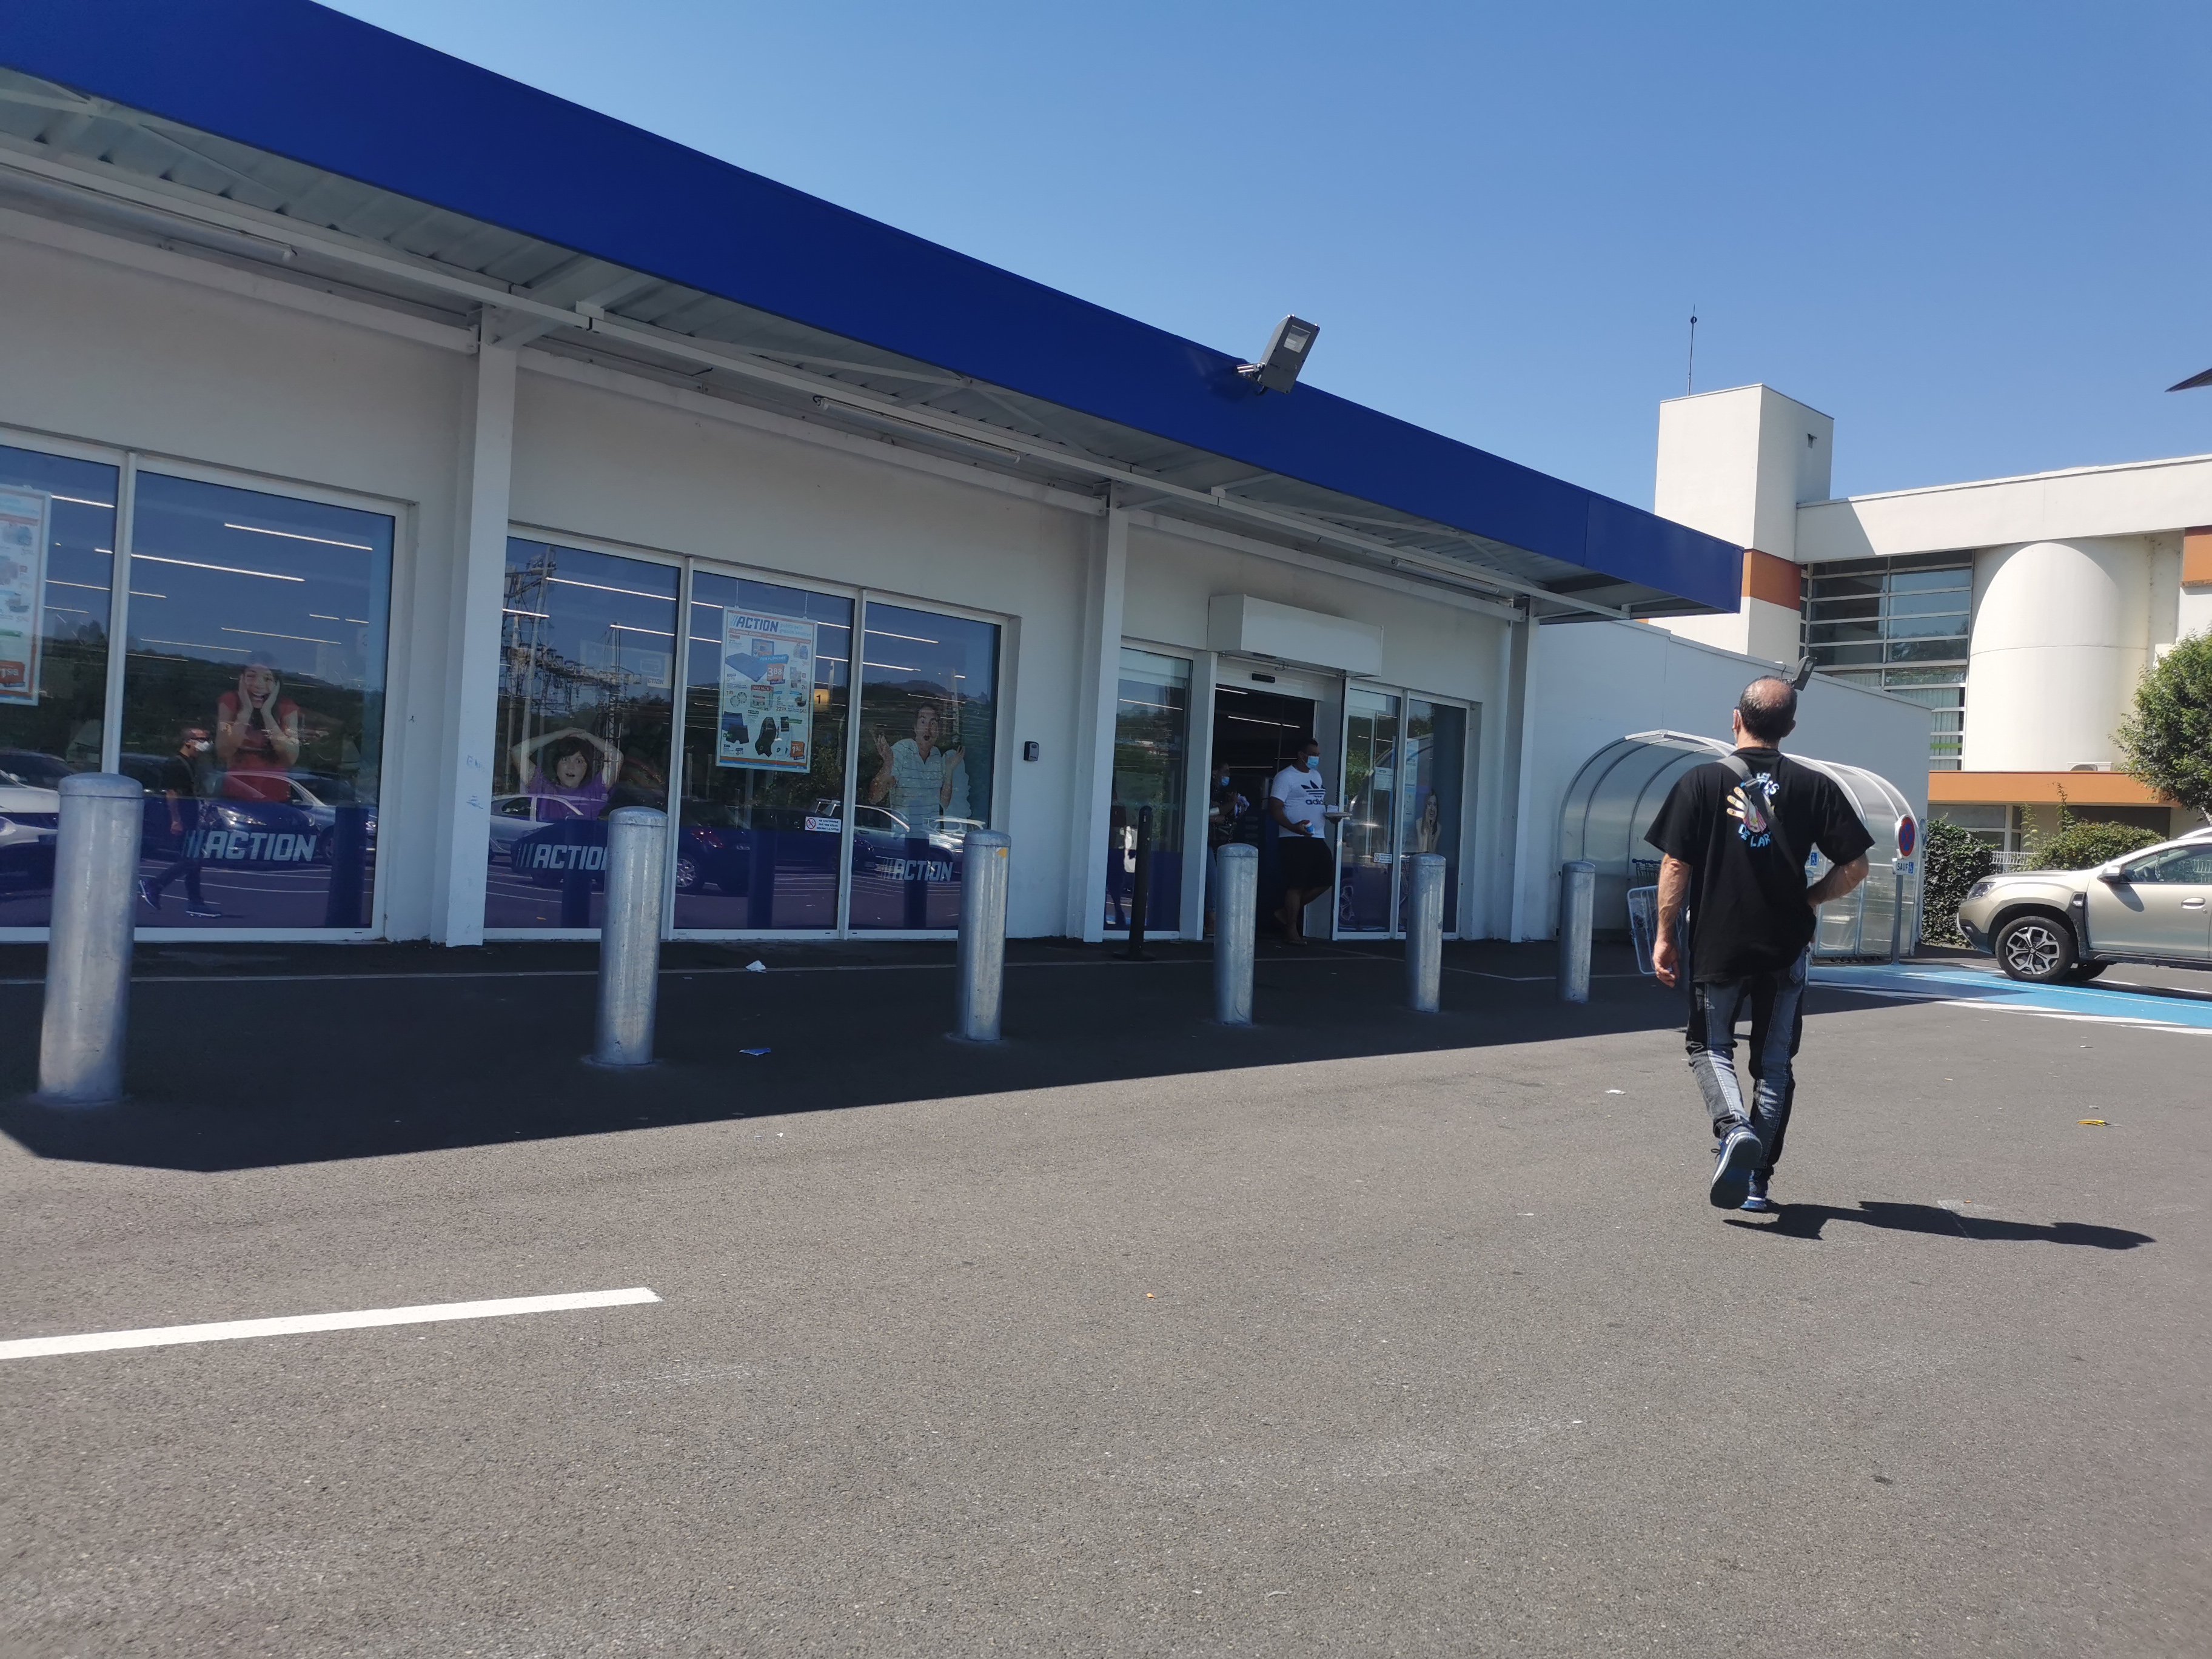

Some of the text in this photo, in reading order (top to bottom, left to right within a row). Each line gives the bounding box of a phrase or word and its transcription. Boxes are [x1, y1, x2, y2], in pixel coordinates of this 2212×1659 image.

[736, 616, 779, 632] ACTION
[204, 831, 317, 862] ACTION
[1750, 832, 1771, 847] L'AR
[893, 859, 954, 882] ACTION
[1897, 862, 1908, 871] SAUF
